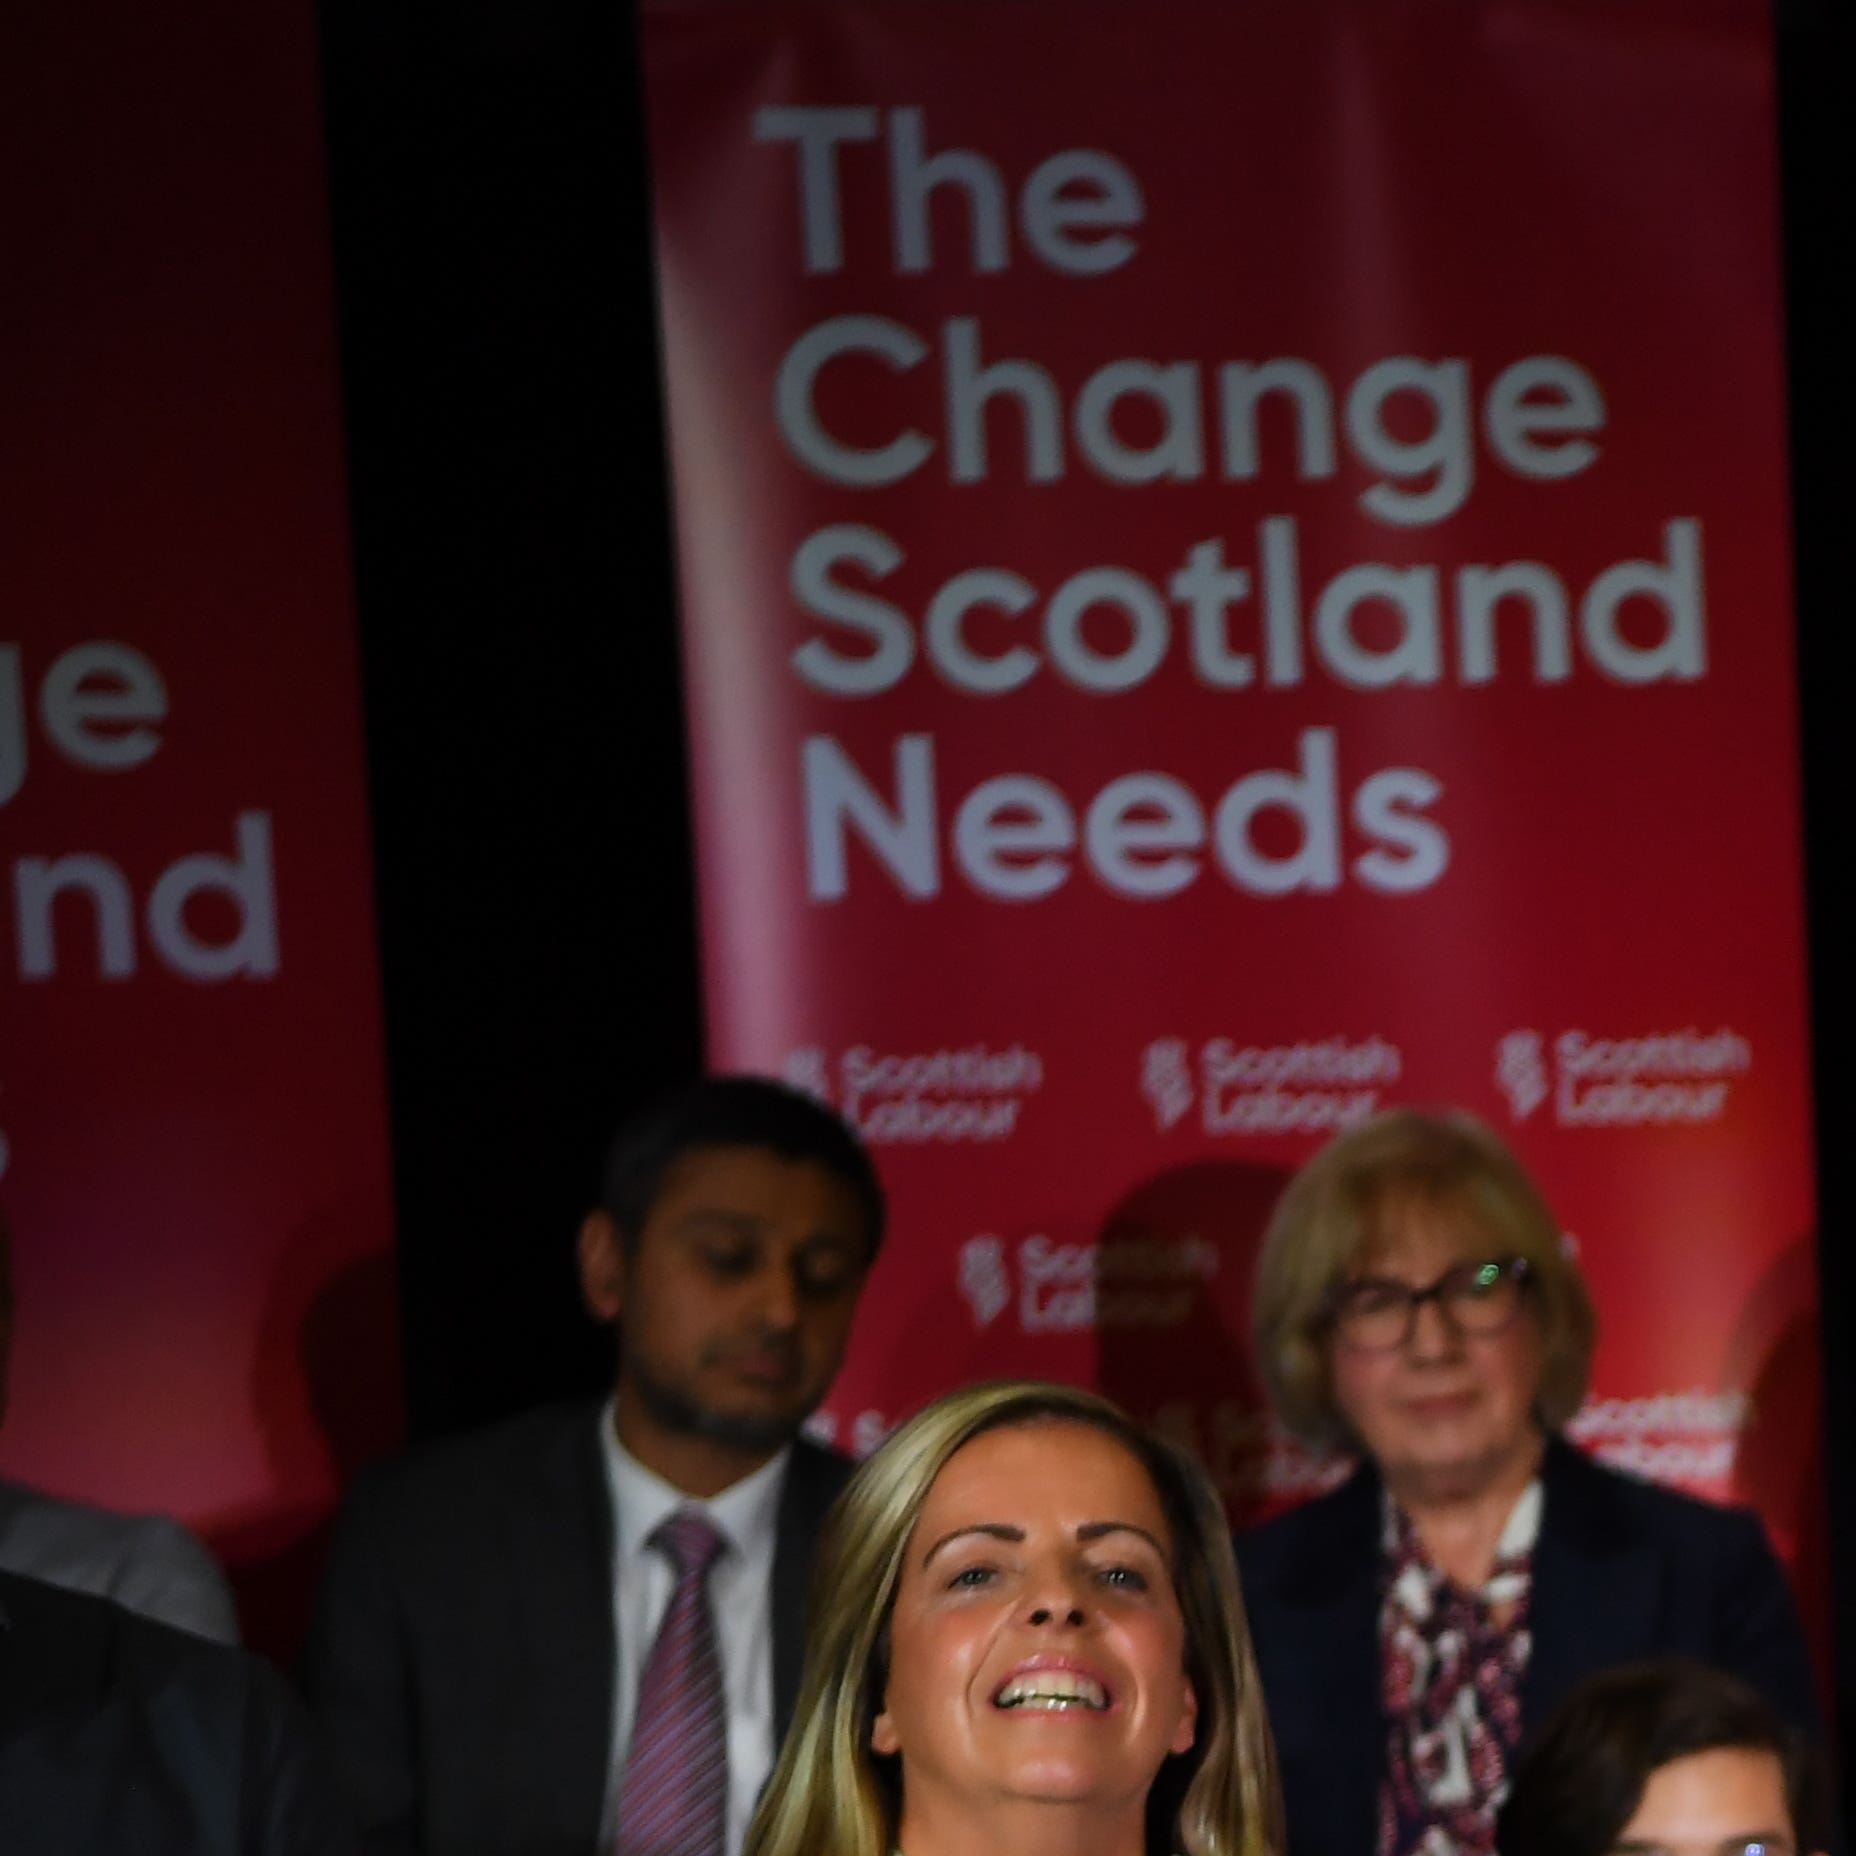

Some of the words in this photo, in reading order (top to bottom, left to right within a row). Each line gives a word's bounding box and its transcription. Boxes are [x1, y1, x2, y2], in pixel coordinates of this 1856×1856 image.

[754, 104, 1145, 276] The
[775, 315, 1607, 525] Change
[790, 516, 1708, 697] Scotland
[802, 728, 1450, 905] Needs
[840, 1043, 1043, 1093] Scottish
[1203, 1035, 1401, 1084] Scottish
[1553, 1027, 1752, 1075] Scottish
[1203, 1084, 1379, 1135] Labour
[1553, 1076, 1730, 1127] Labour
